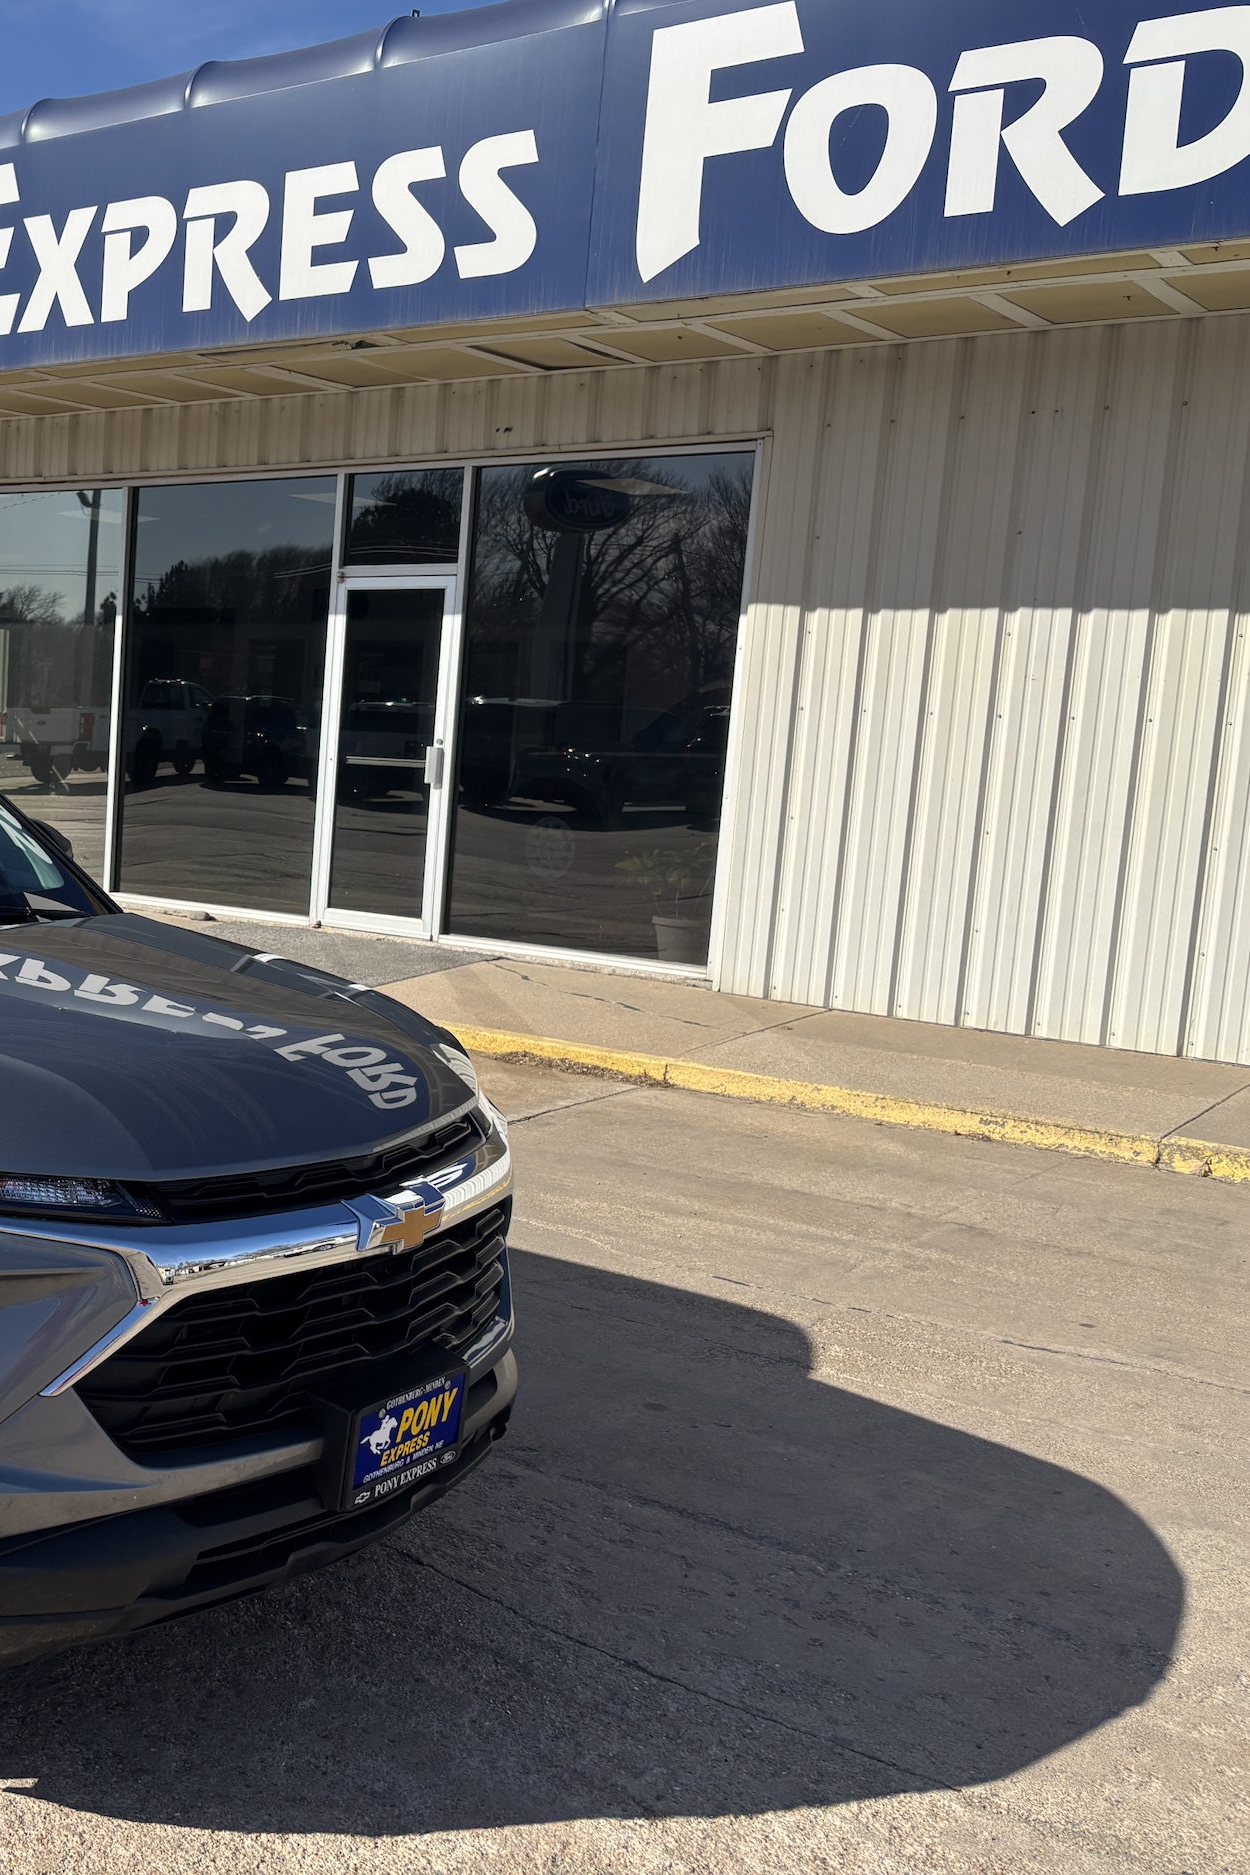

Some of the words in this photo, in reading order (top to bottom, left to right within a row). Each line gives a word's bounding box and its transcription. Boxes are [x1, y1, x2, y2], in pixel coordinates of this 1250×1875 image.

[635, 0, 1250, 284] FORD
[395, 1387, 458, 1443] PONY
[380, 1431, 430, 1467] EXPRESS
[363, 1459, 405, 1483] GOTHENBURG
[374, 1475, 400, 1498] PONY
[400, 1458, 437, 1486] EXPRESS
